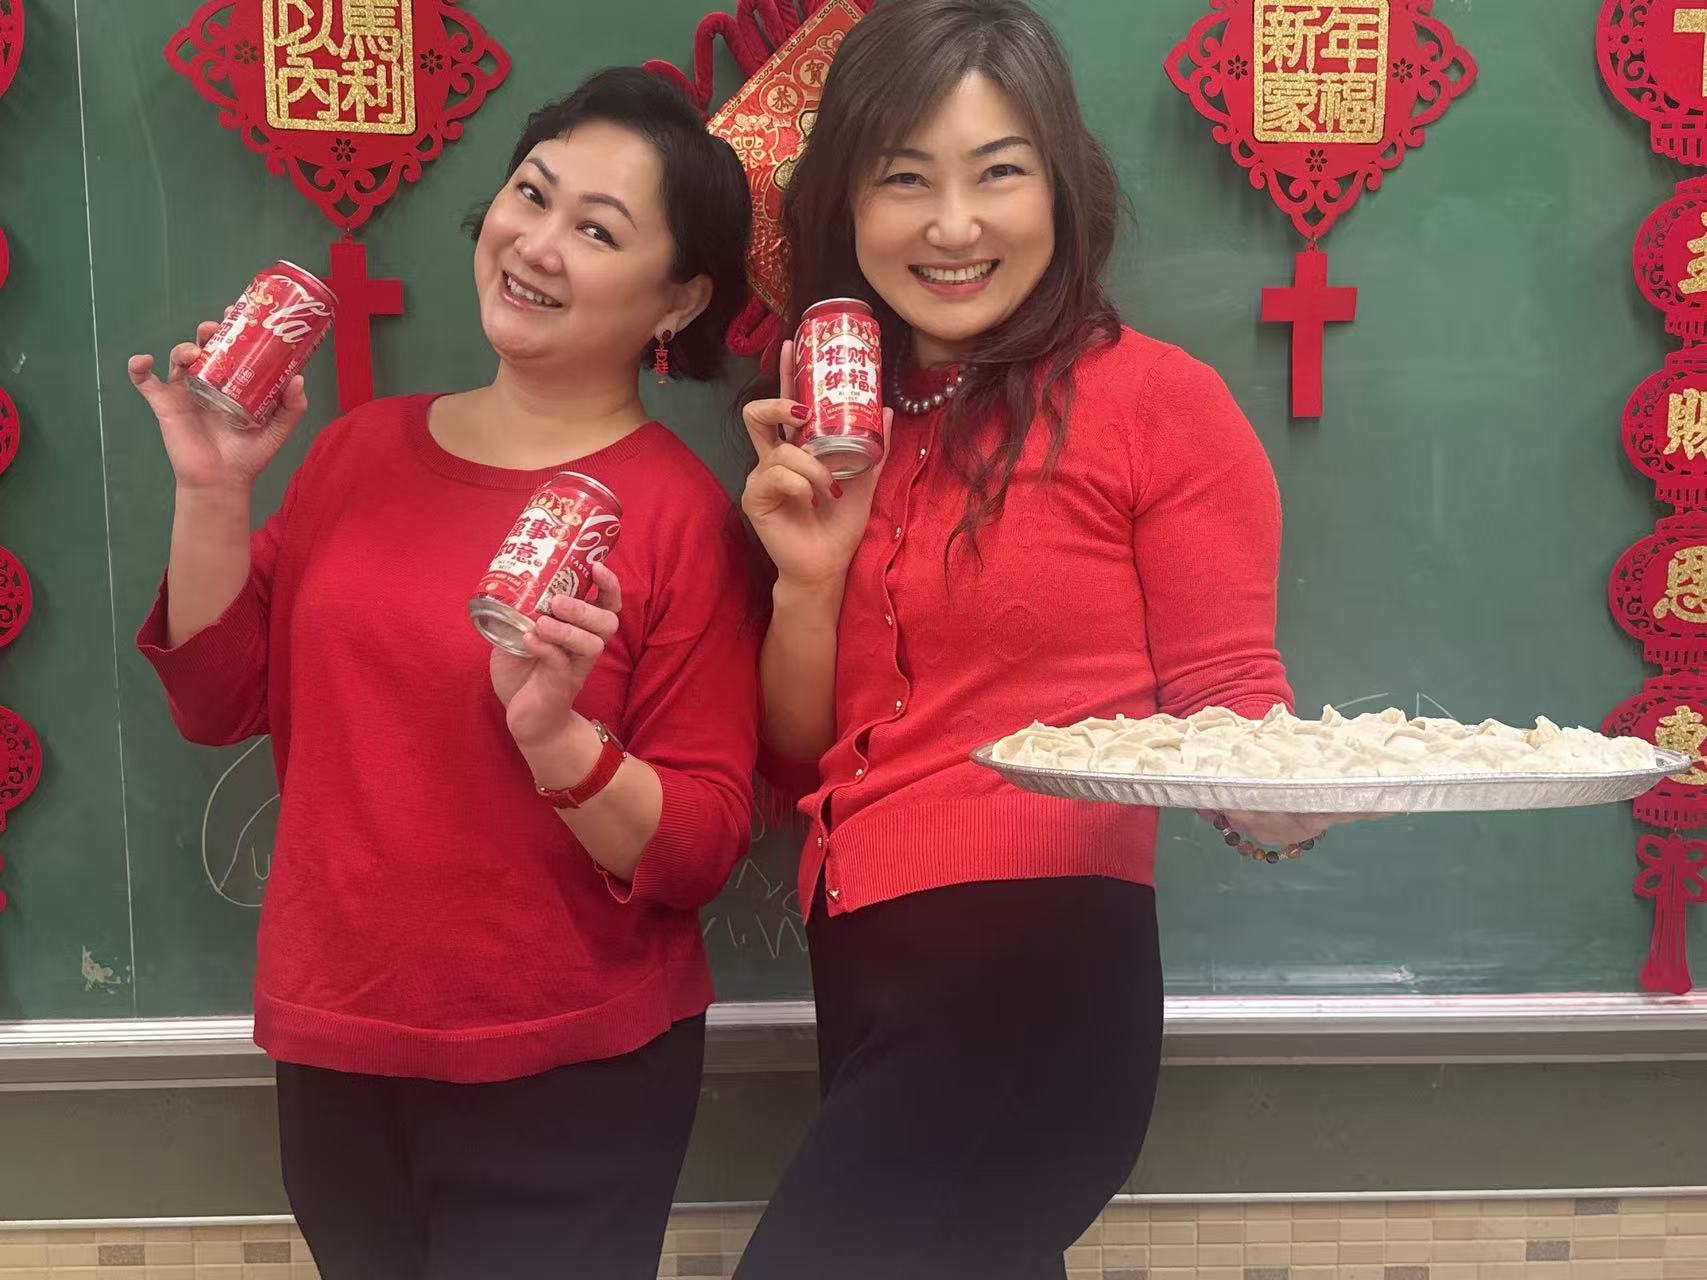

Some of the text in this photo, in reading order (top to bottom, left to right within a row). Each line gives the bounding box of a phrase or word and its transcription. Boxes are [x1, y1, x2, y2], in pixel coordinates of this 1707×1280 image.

[1263, 6, 1379, 73] 新年
[1262, 70, 1378, 132] 蒙福
[825, 345, 867, 368] 招财
[825, 368, 870, 392] 纳福
[253, 358, 298, 418] RECYCLE ME
